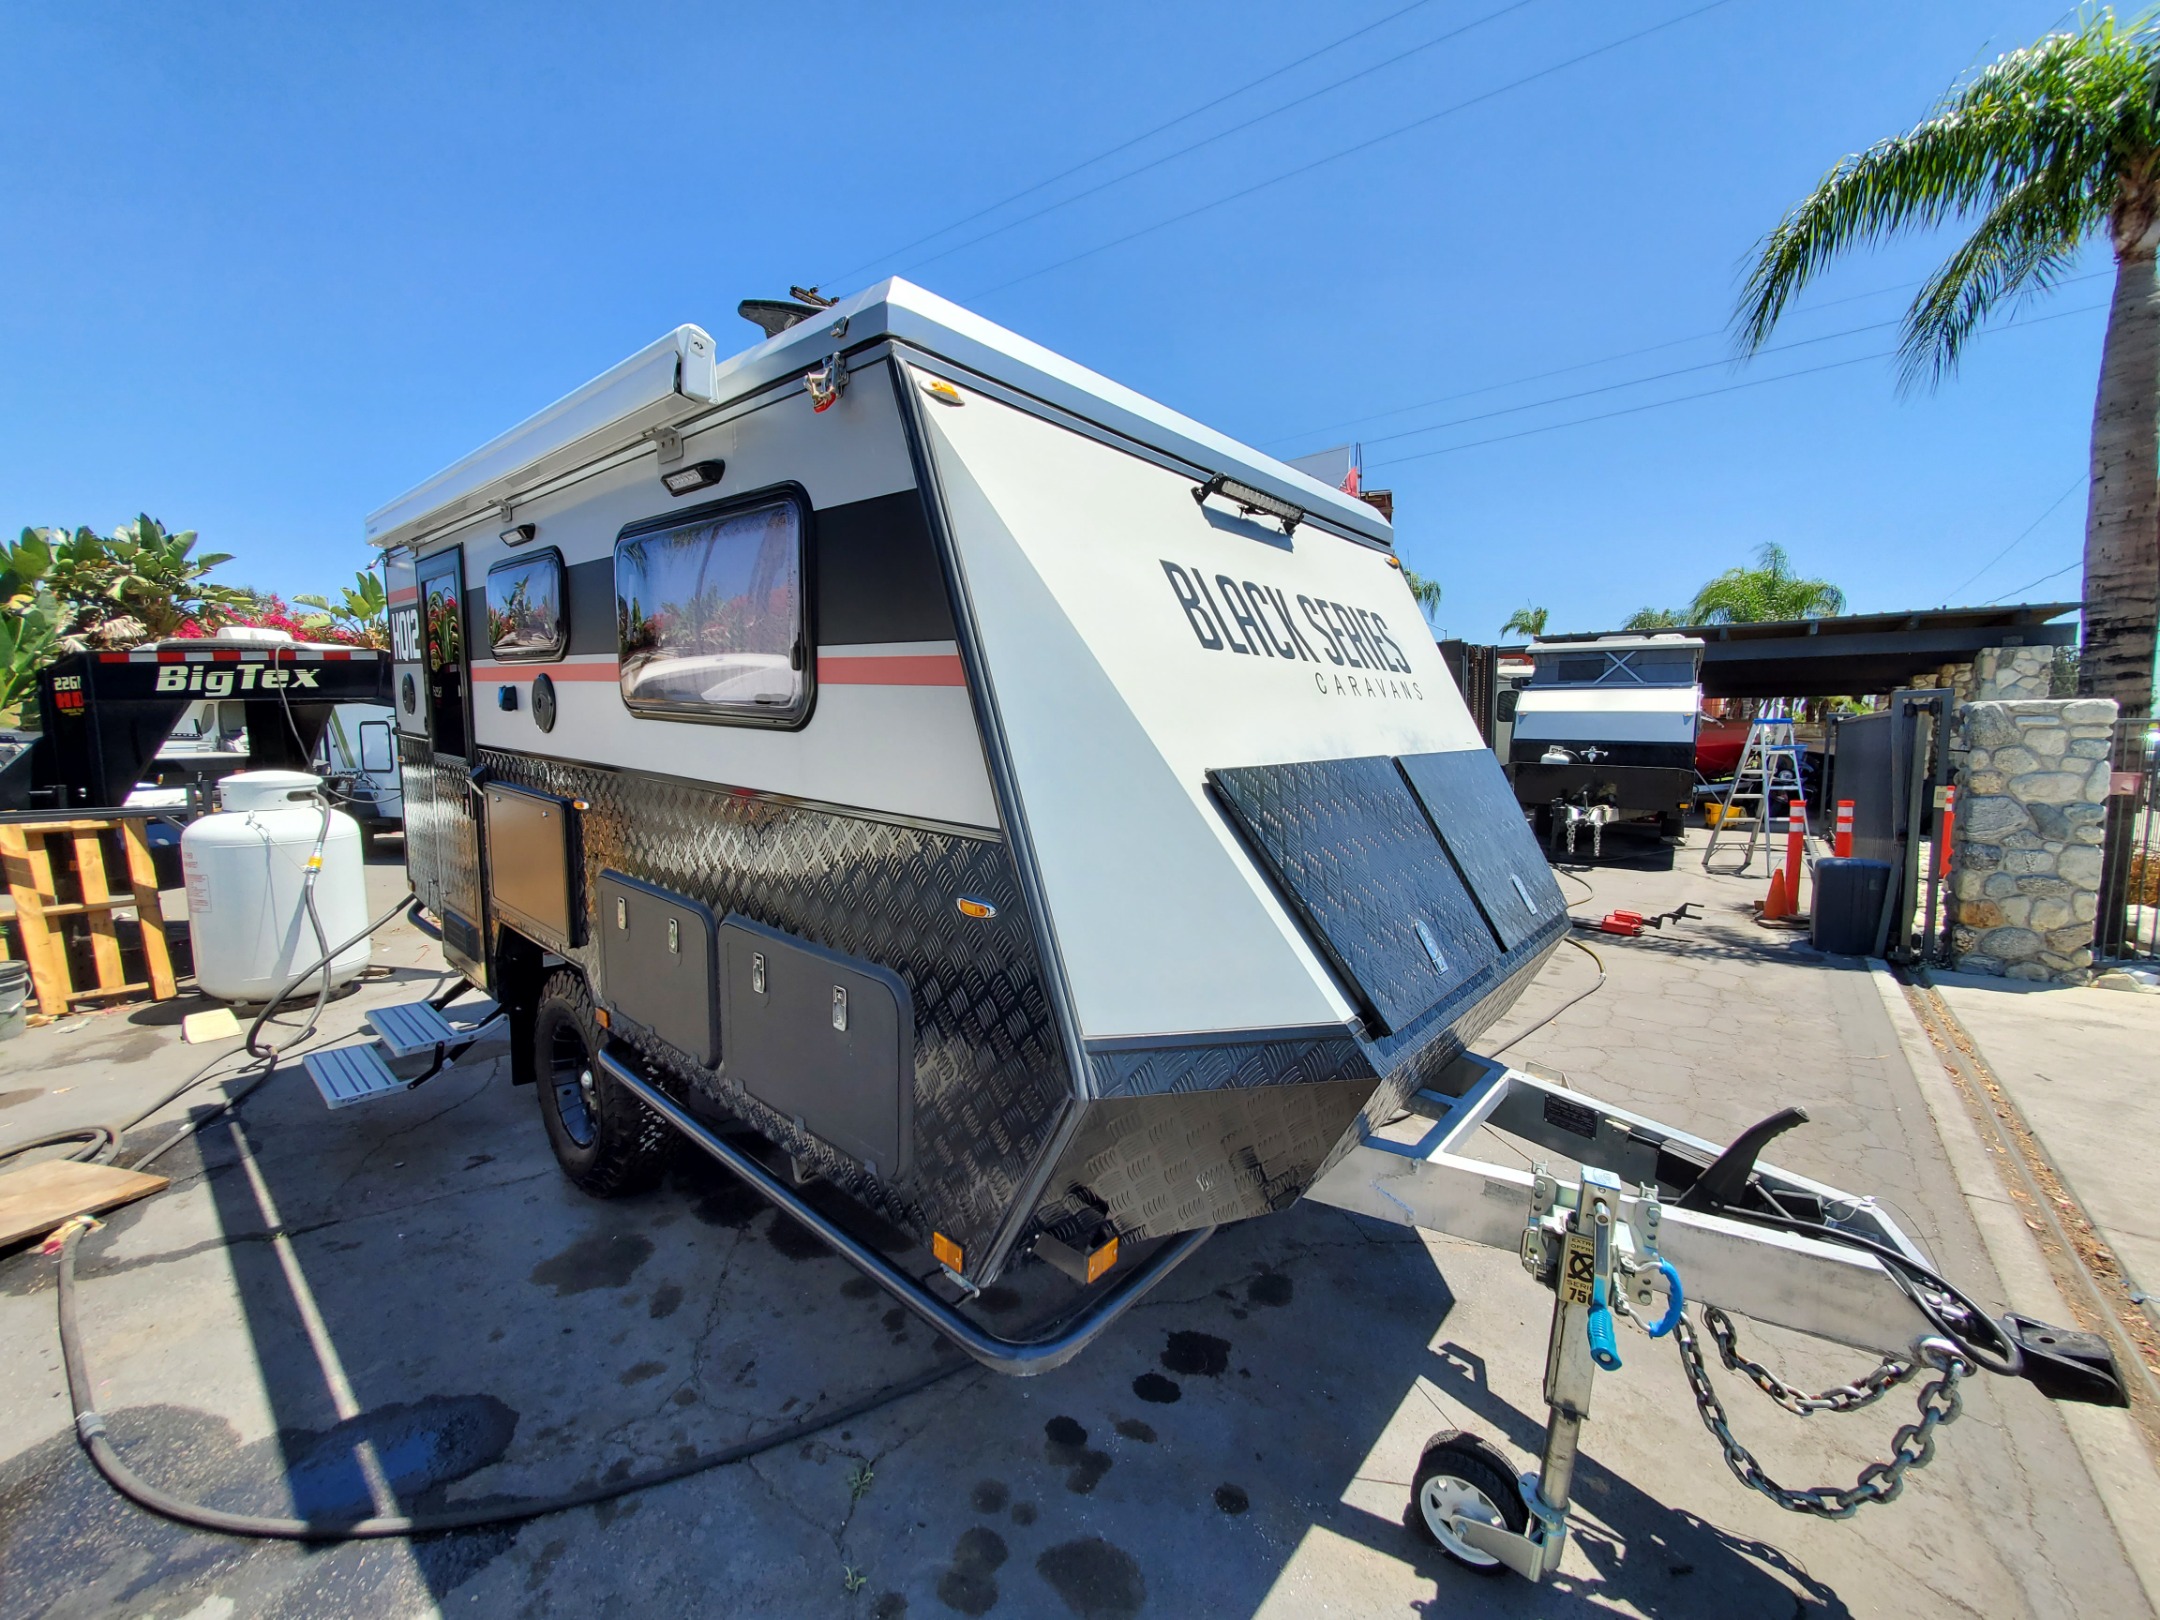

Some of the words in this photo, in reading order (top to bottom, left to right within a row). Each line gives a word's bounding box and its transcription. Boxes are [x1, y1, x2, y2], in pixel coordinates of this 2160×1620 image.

[1159, 559, 1321, 663] BLACK
[1296, 594, 1412, 674] SERIES
[391, 608, 421, 661] HQ12
[1315, 672, 1423, 701] CARAVANS
[1570, 1243, 1594, 1254] OFFR
[1571, 1237, 1594, 1247] EXTR
[1567, 1279, 1592, 1292] SERI
